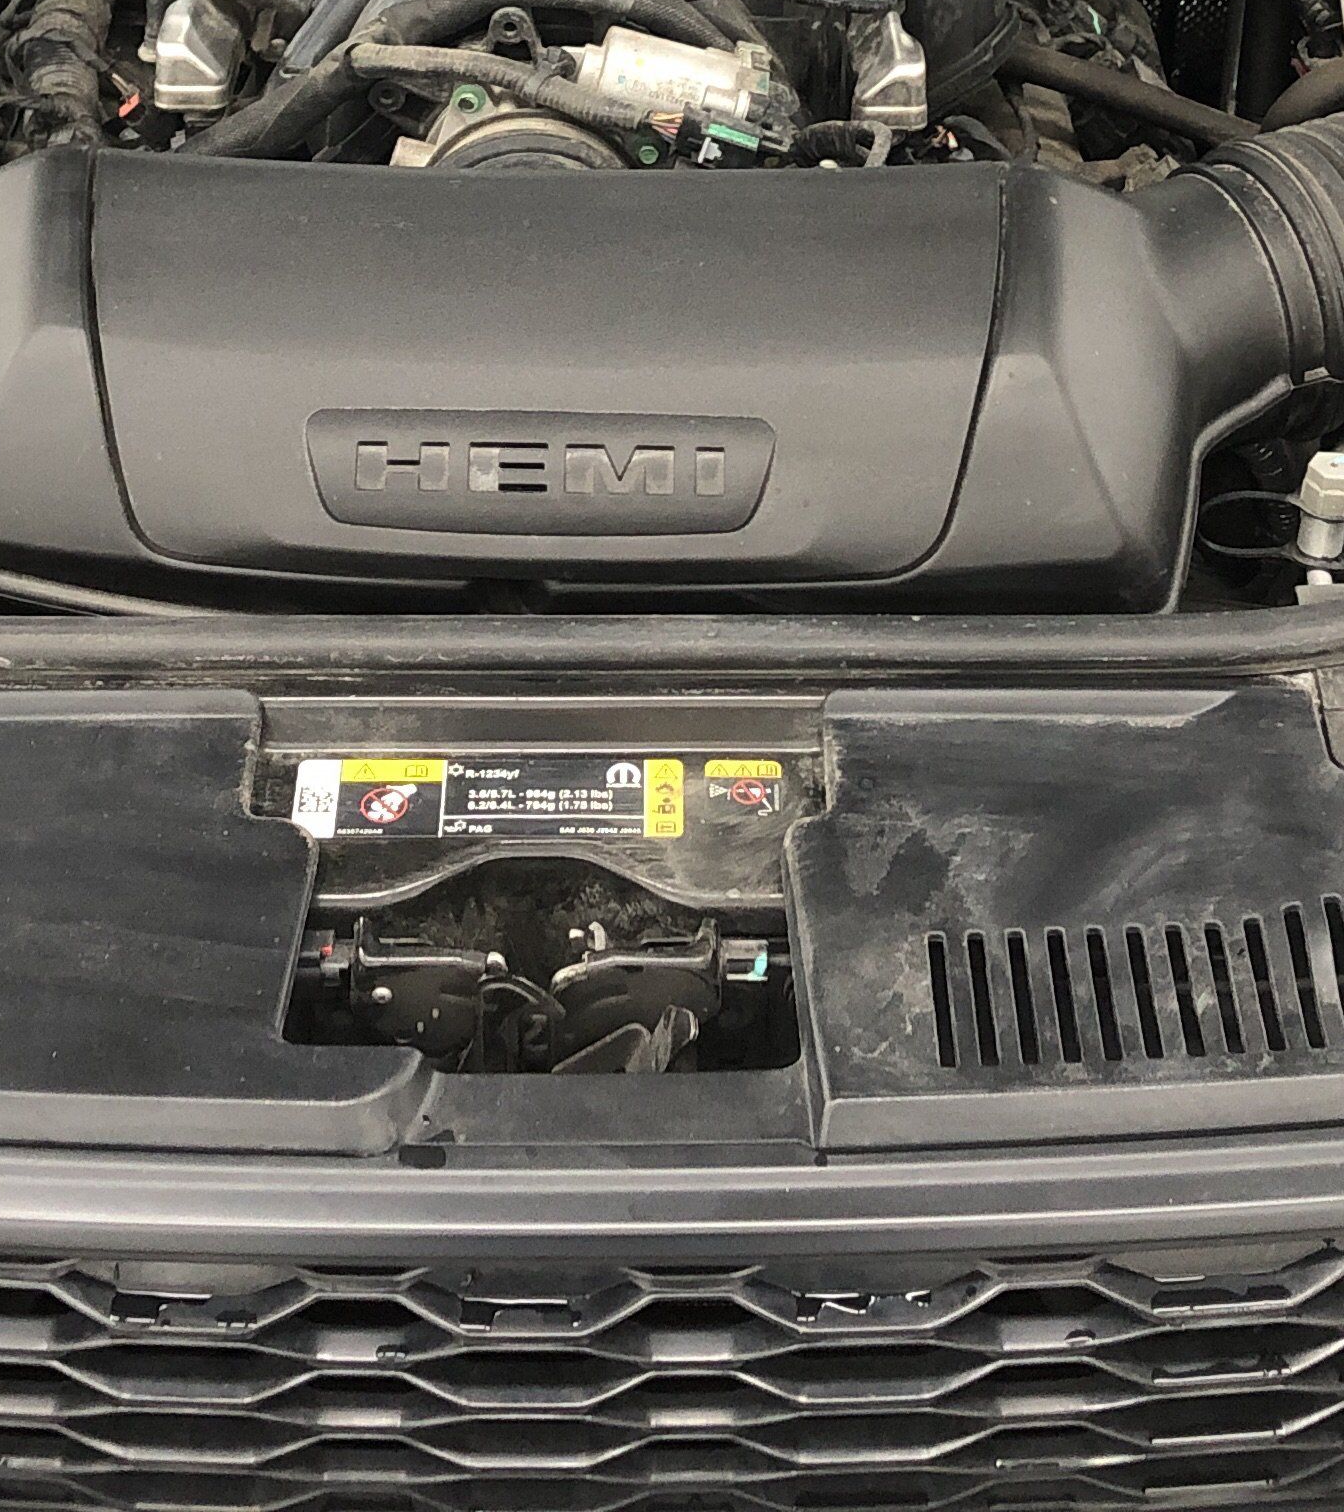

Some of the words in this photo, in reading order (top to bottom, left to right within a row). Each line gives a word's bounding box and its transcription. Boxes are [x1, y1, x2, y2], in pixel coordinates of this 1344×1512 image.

[354, 440, 726, 497] HEMI
[465, 769, 520, 780] R-1234yf
[559, 789, 588, 800] (2.13
[590, 789, 613, 800] lbs)
[590, 800, 613, 811] lbs)
[468, 825, 493, 834] PAG
